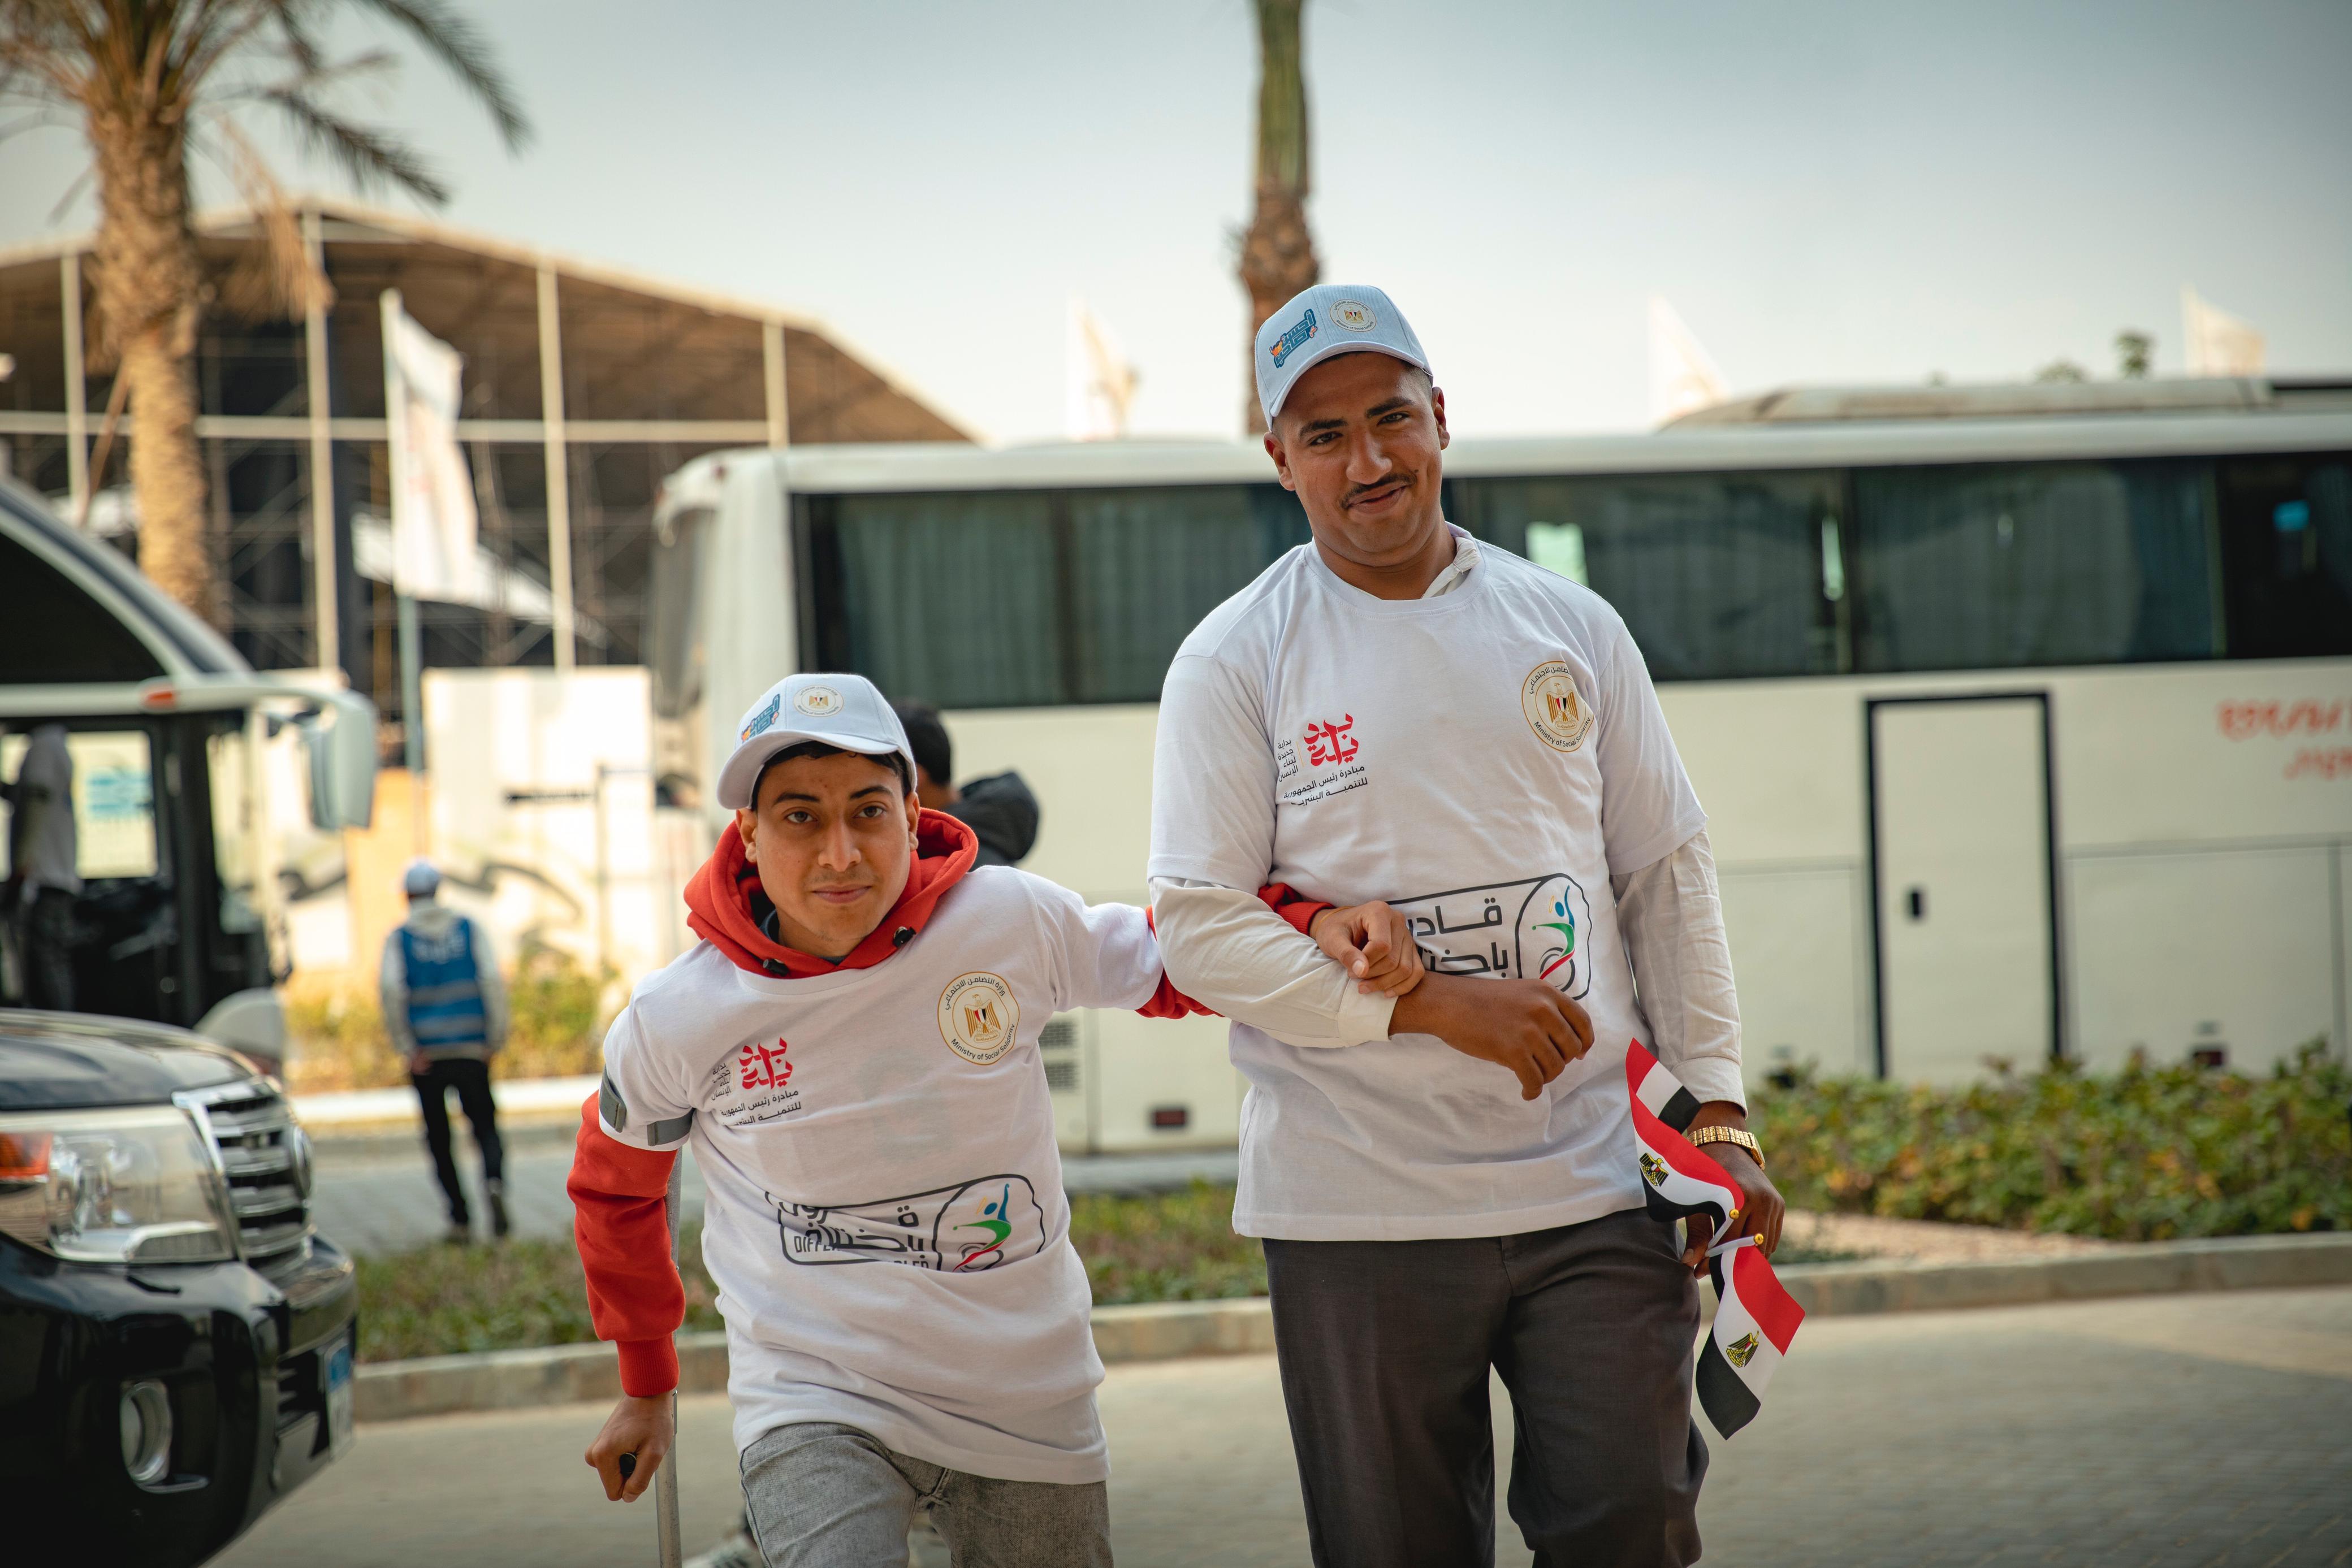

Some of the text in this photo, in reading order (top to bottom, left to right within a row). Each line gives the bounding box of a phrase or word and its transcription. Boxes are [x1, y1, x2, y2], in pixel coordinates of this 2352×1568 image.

[1529, 666, 1550, 694] الاجتماعي
[1278, 739, 1291, 750] بداية
[1534, 721, 1555, 744] Ministry
[1563, 738, 1576, 747] Social
[1576, 717, 1591, 743] Solidarity
[1278, 748, 1294, 760] جديدة
[1283, 755, 1296, 768] لبناء
[1283, 765, 1365, 799] مبادرة رئيس الجمهورية
[1325, 777, 1368, 796] للتنمية
[945, 976, 1005, 1010] وزارة التضامن الاجتماعي
[951, 1038, 976, 1059] Ministry
[985, 1050, 1000, 1060] Social
[1000, 1024, 1015, 1052] Solidarity
[720, 1090, 799, 1117] مبادرة رئيس الجمهورية
[758, 1102, 802, 1121] للتنمية
